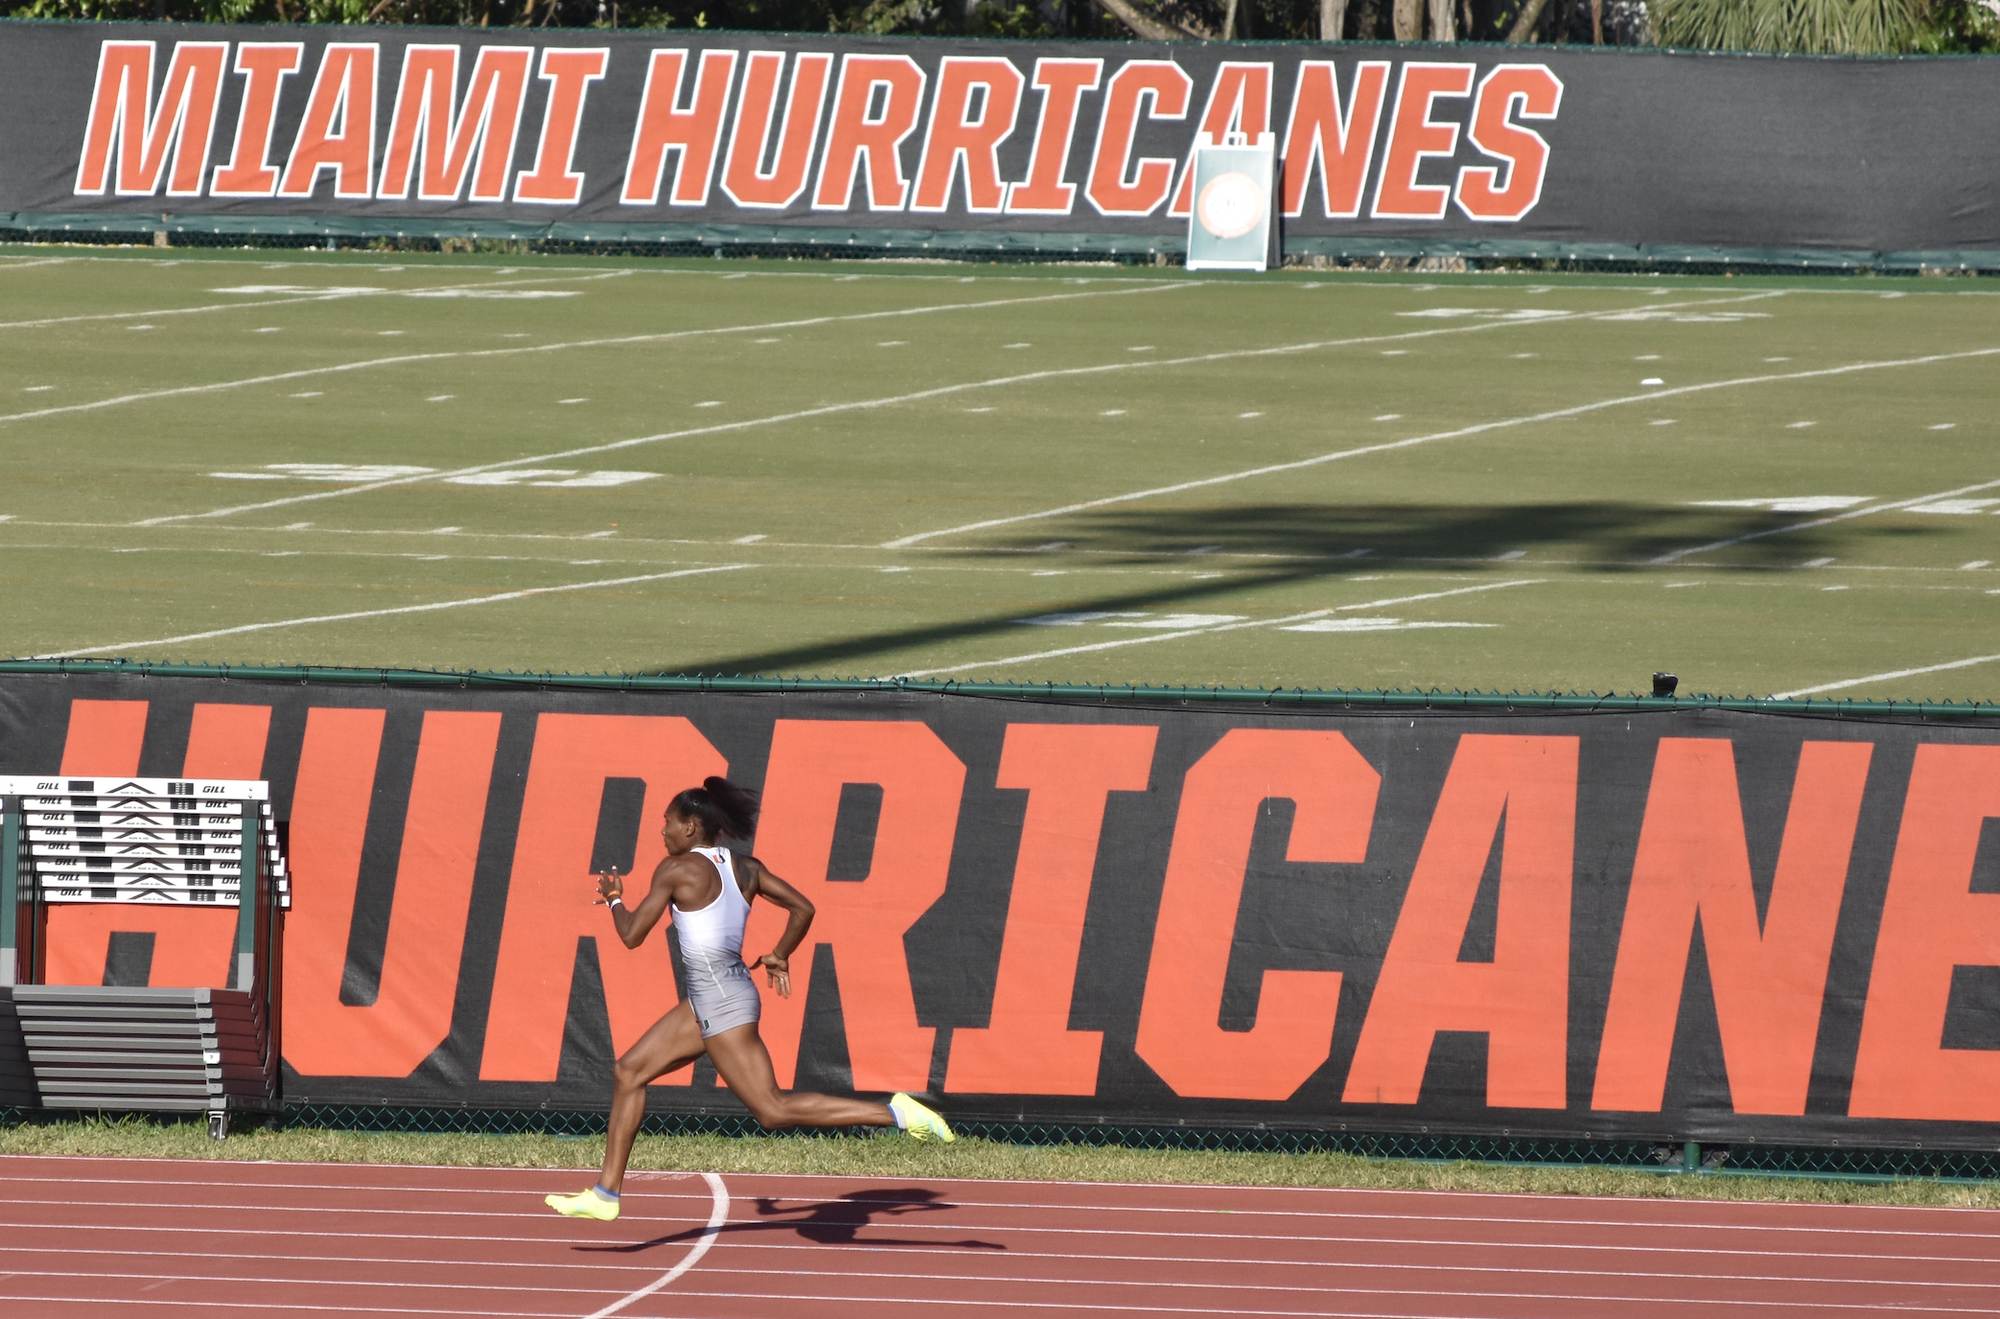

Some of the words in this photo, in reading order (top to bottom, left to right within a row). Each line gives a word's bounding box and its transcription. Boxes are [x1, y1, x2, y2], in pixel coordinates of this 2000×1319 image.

[73, 40, 610, 204] MIAMI
[619, 48, 1564, 222] HURRICANES
[202, 786, 226, 794] GILL
[205, 800, 228, 808] GILL
[42, 812, 66, 821] GILL
[208, 816, 232, 824] GILL
[44, 827, 68, 835] GILL
[210, 831, 234, 839] GILL
[47, 842, 71, 850] GILL
[213, 846, 236, 854] GILL
[54, 858, 78, 866] GILL
[57, 873, 80, 881] GILL
[221, 876, 242, 884] GIL
[60, 888, 83, 896] GILL
